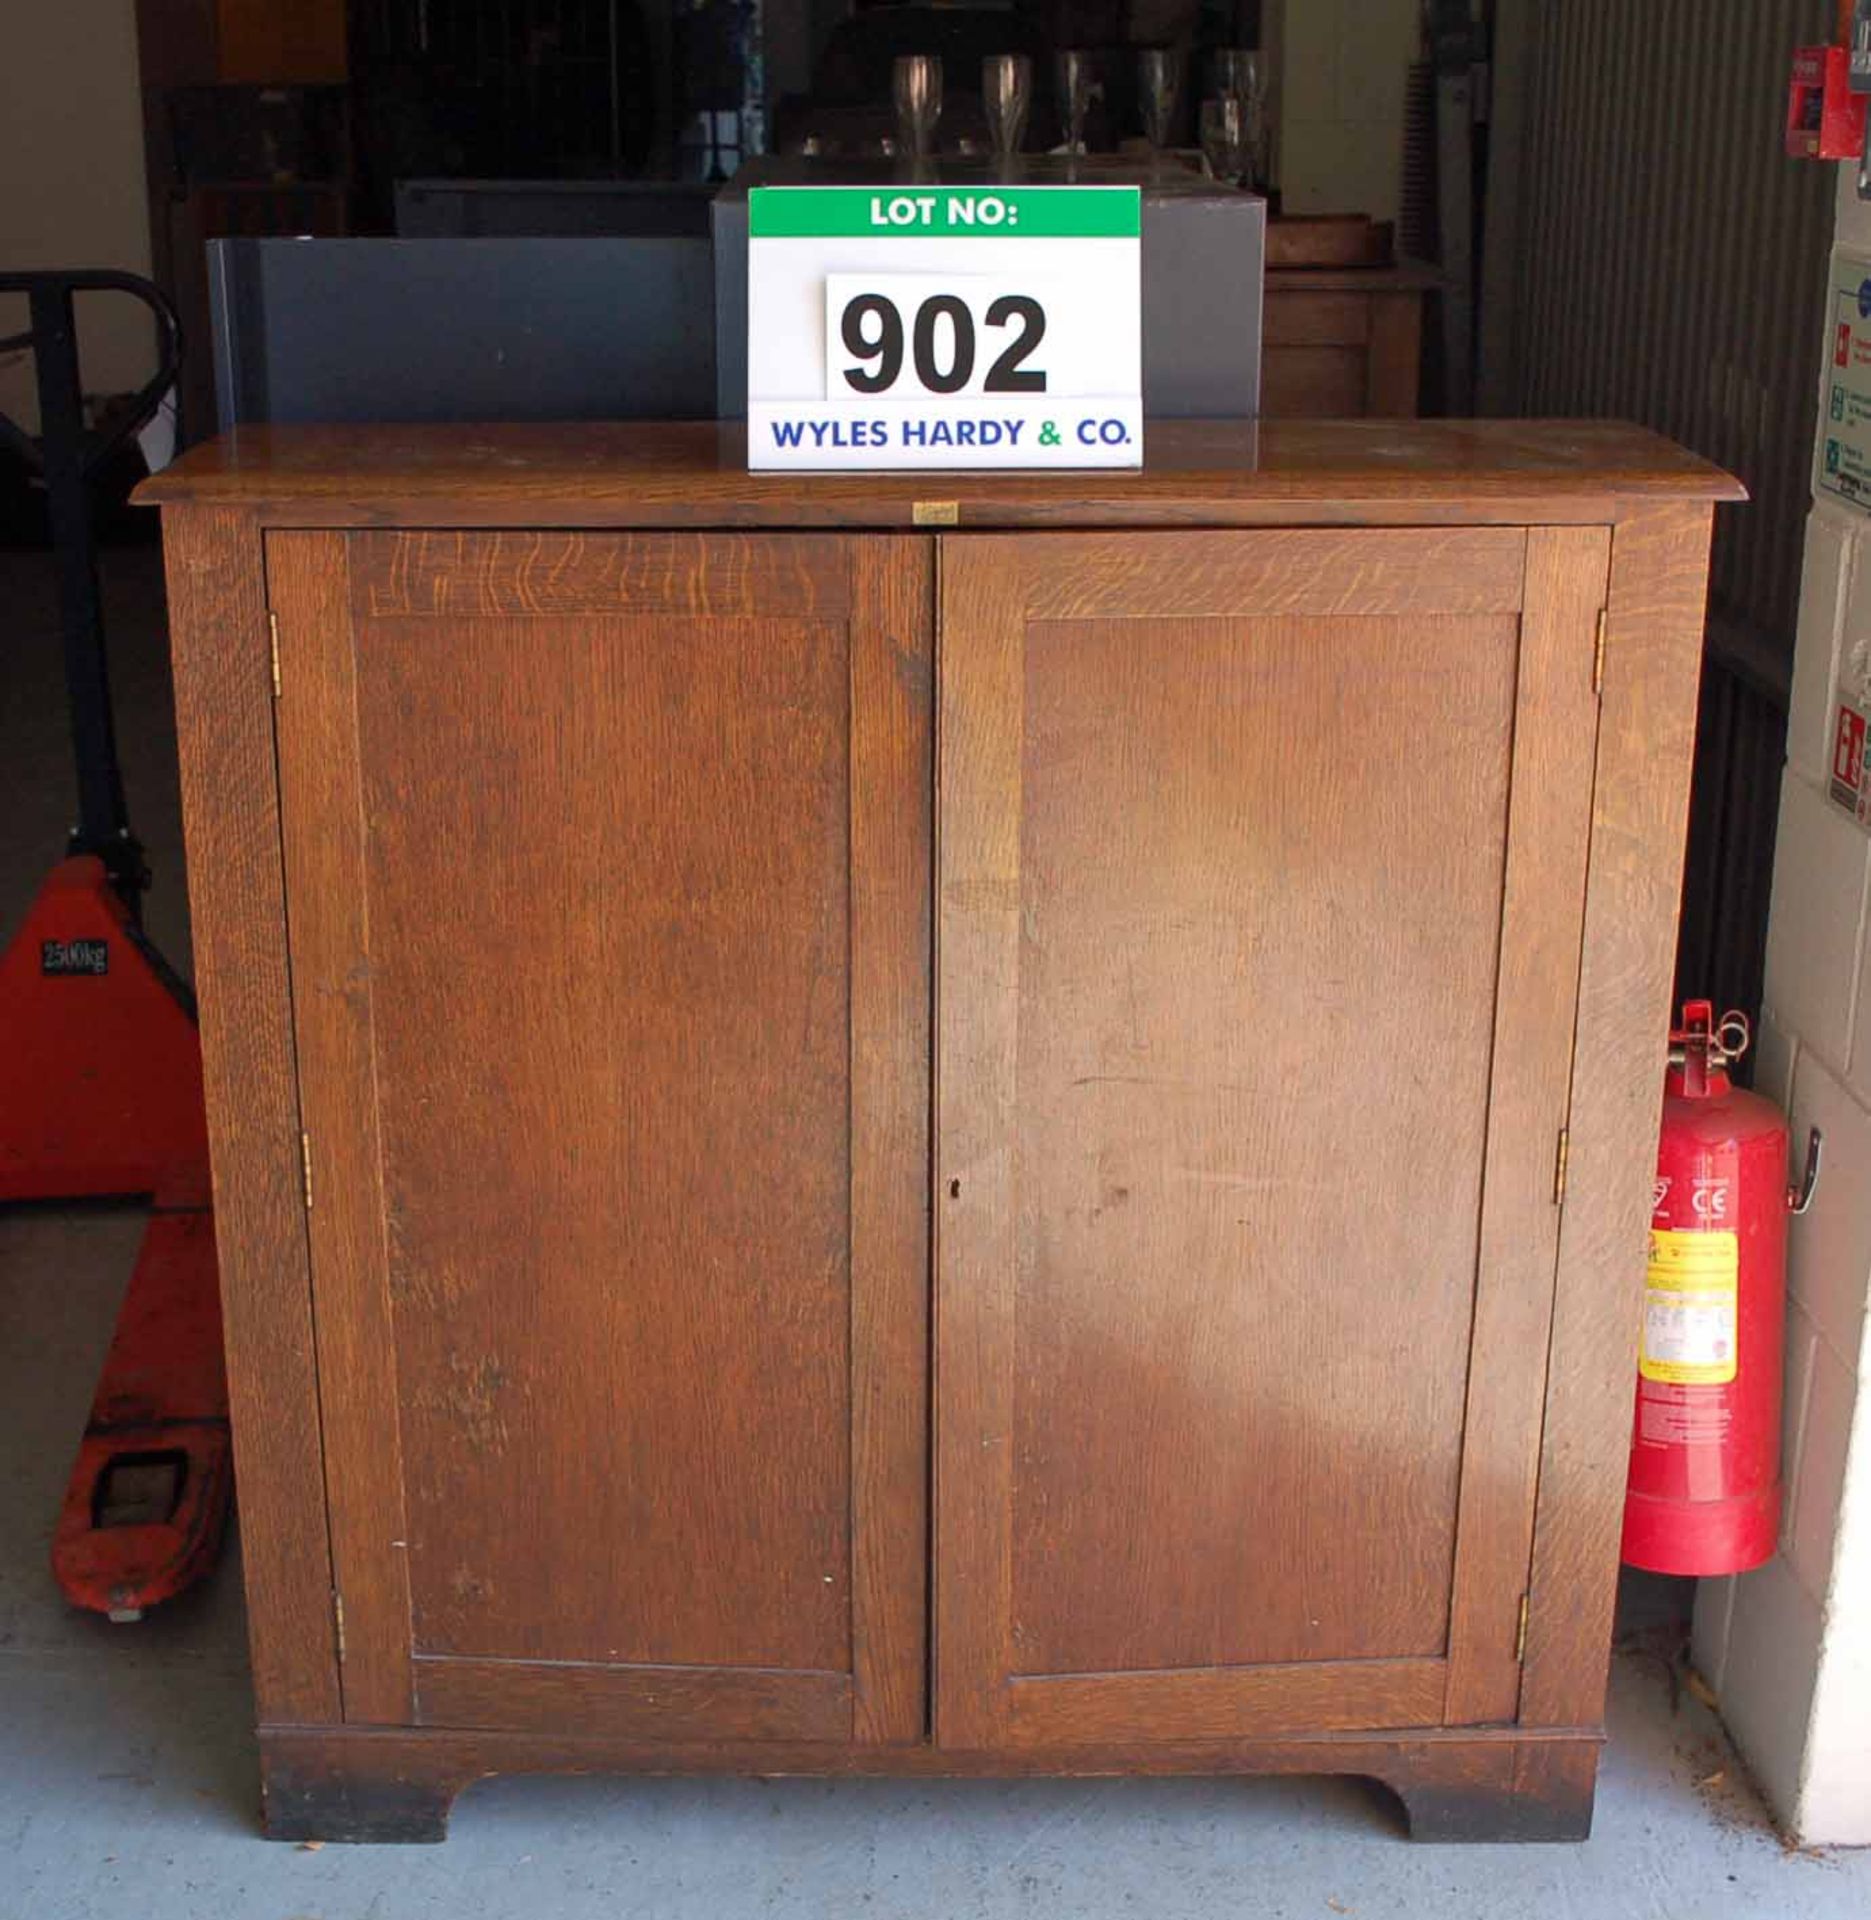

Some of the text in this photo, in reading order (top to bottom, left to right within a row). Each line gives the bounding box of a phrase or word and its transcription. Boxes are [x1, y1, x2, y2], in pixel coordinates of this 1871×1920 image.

[870, 197, 1019, 226] LOT NO:
[840, 293, 1047, 394] 902
[771, 418, 1132, 447] WYLES HARDY & CO.
